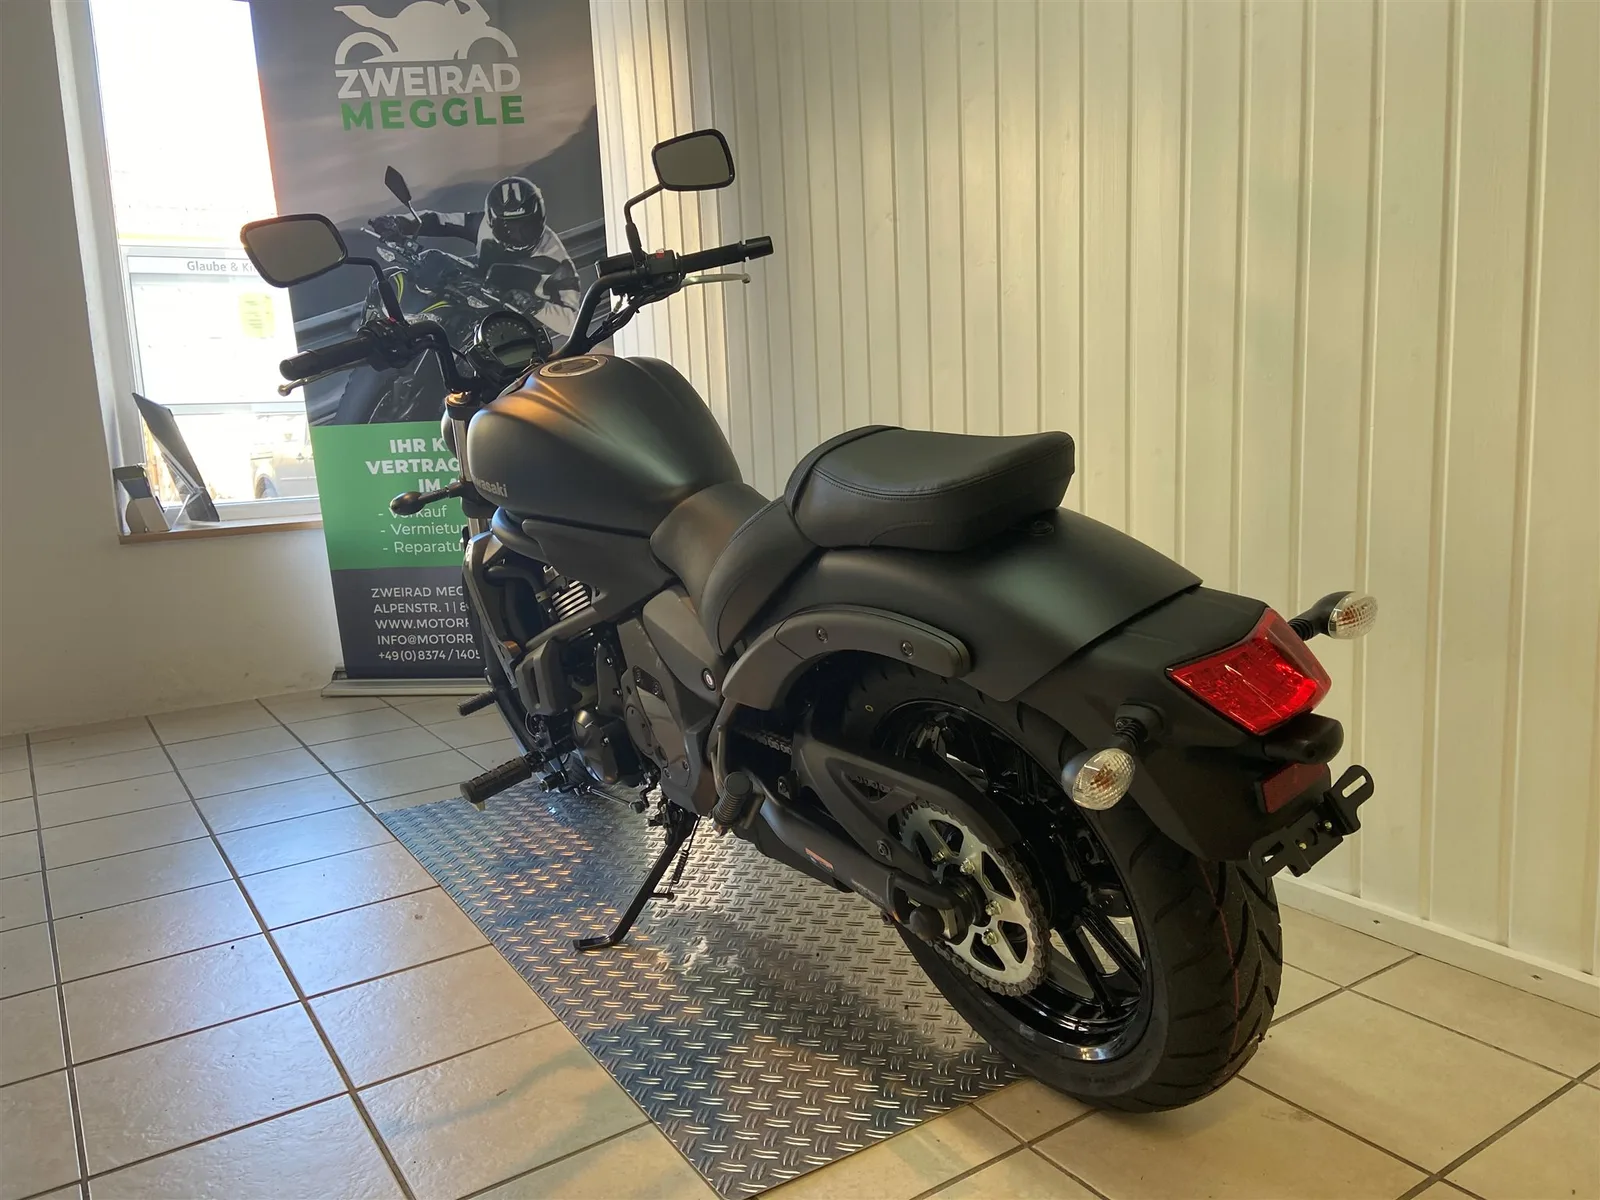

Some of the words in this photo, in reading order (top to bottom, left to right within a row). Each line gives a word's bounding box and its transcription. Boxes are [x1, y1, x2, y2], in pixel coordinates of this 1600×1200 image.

[335, 63, 521, 99] ZWEIRAD
[340, 95, 525, 131] MEGGLE
[187, 260, 227, 272] Glaube
[230, 262, 239, 272] &
[242, 262, 257, 273] Ki
[389, 438, 426, 454] IHR
[432, 438, 449, 452] K
[418, 478, 441, 493] IM
[394, 541, 465, 556] Reparatu
[371, 586, 432, 598] ZWEIRAD
[373, 602, 442, 614] ALPENSTR.
[377, 634, 474, 645] INFO@MOTORR
